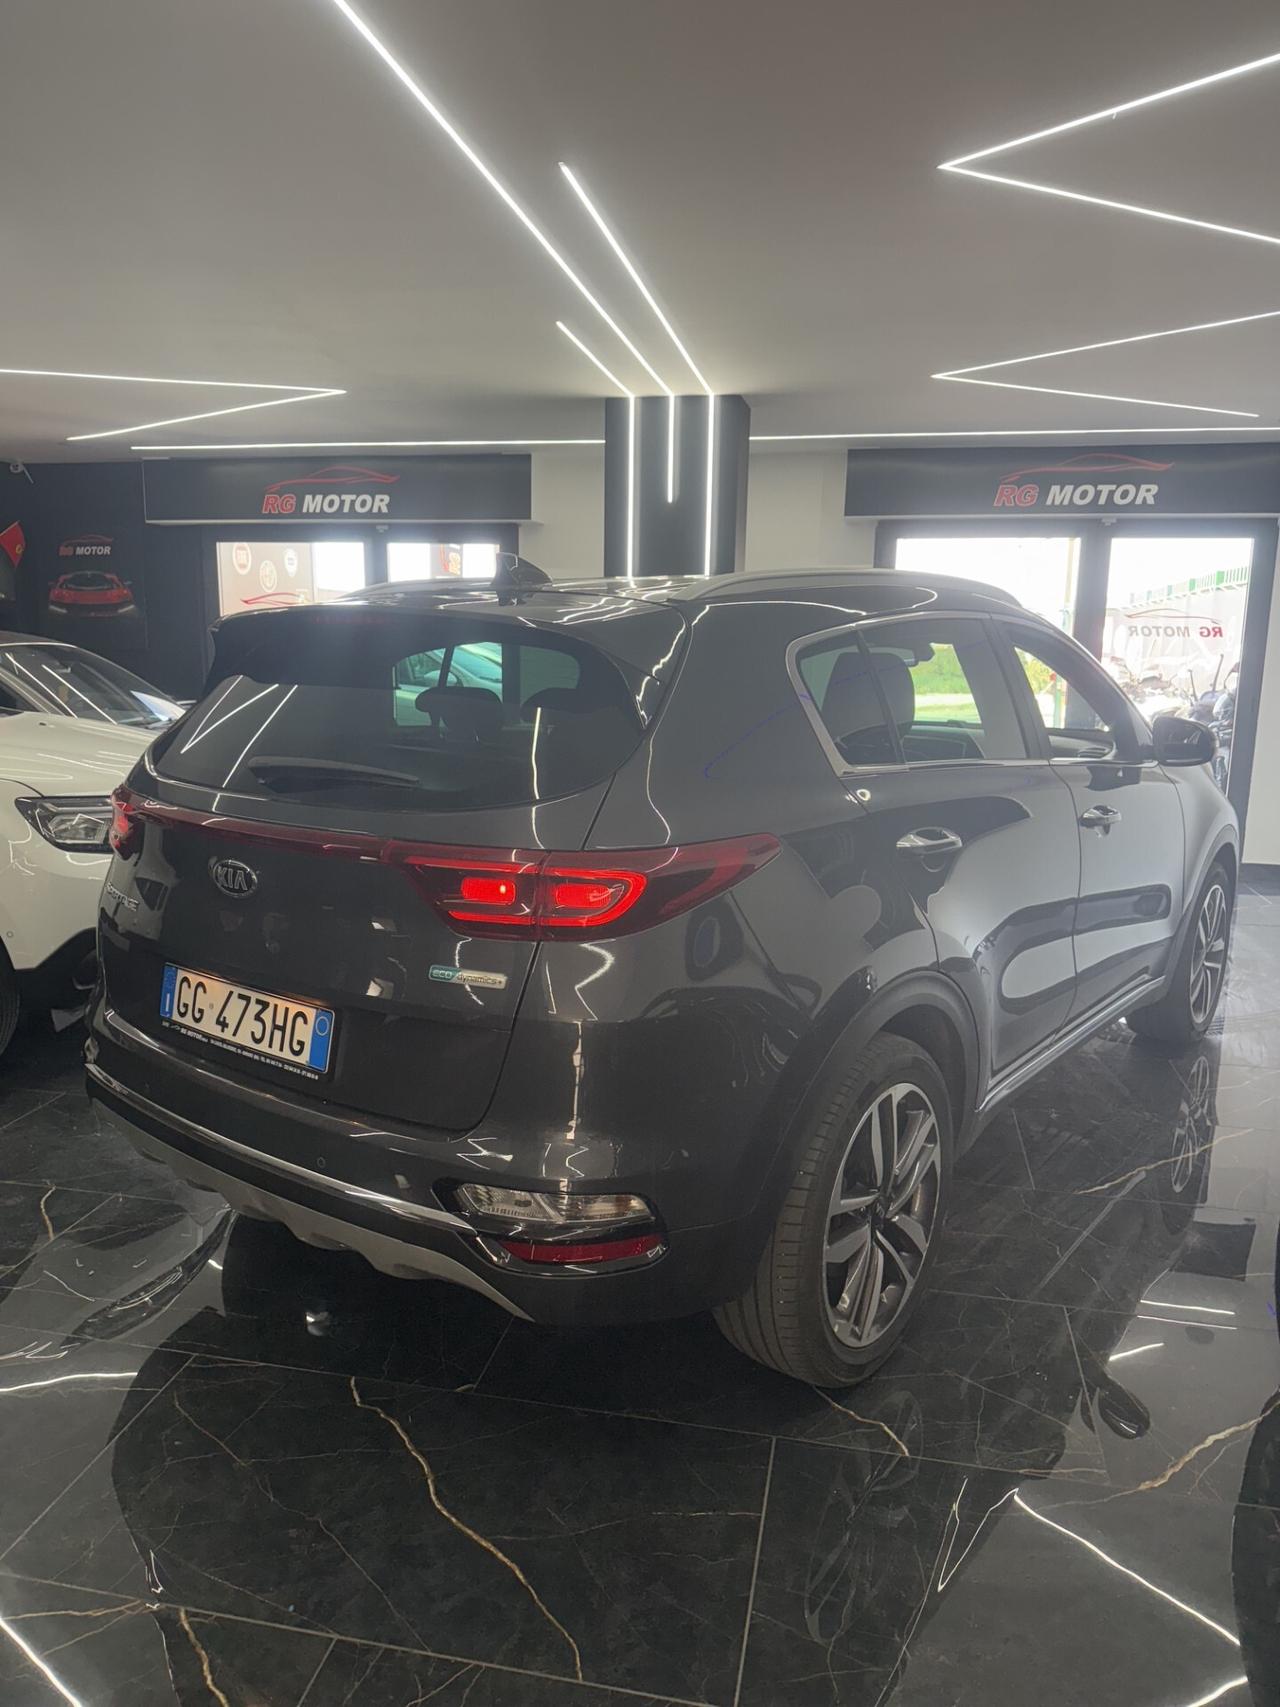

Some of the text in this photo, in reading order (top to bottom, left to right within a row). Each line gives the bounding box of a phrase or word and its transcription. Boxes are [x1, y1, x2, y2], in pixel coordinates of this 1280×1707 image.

[261, 494, 390, 514] RG MOTOR
[993, 484, 1159, 507] RG MOTOR
[75, 545, 111, 556] MOTOR
[217, 866, 248, 891] KIA
[176, 976, 207, 1024] GG
[215, 990, 308, 1057] 473HG
